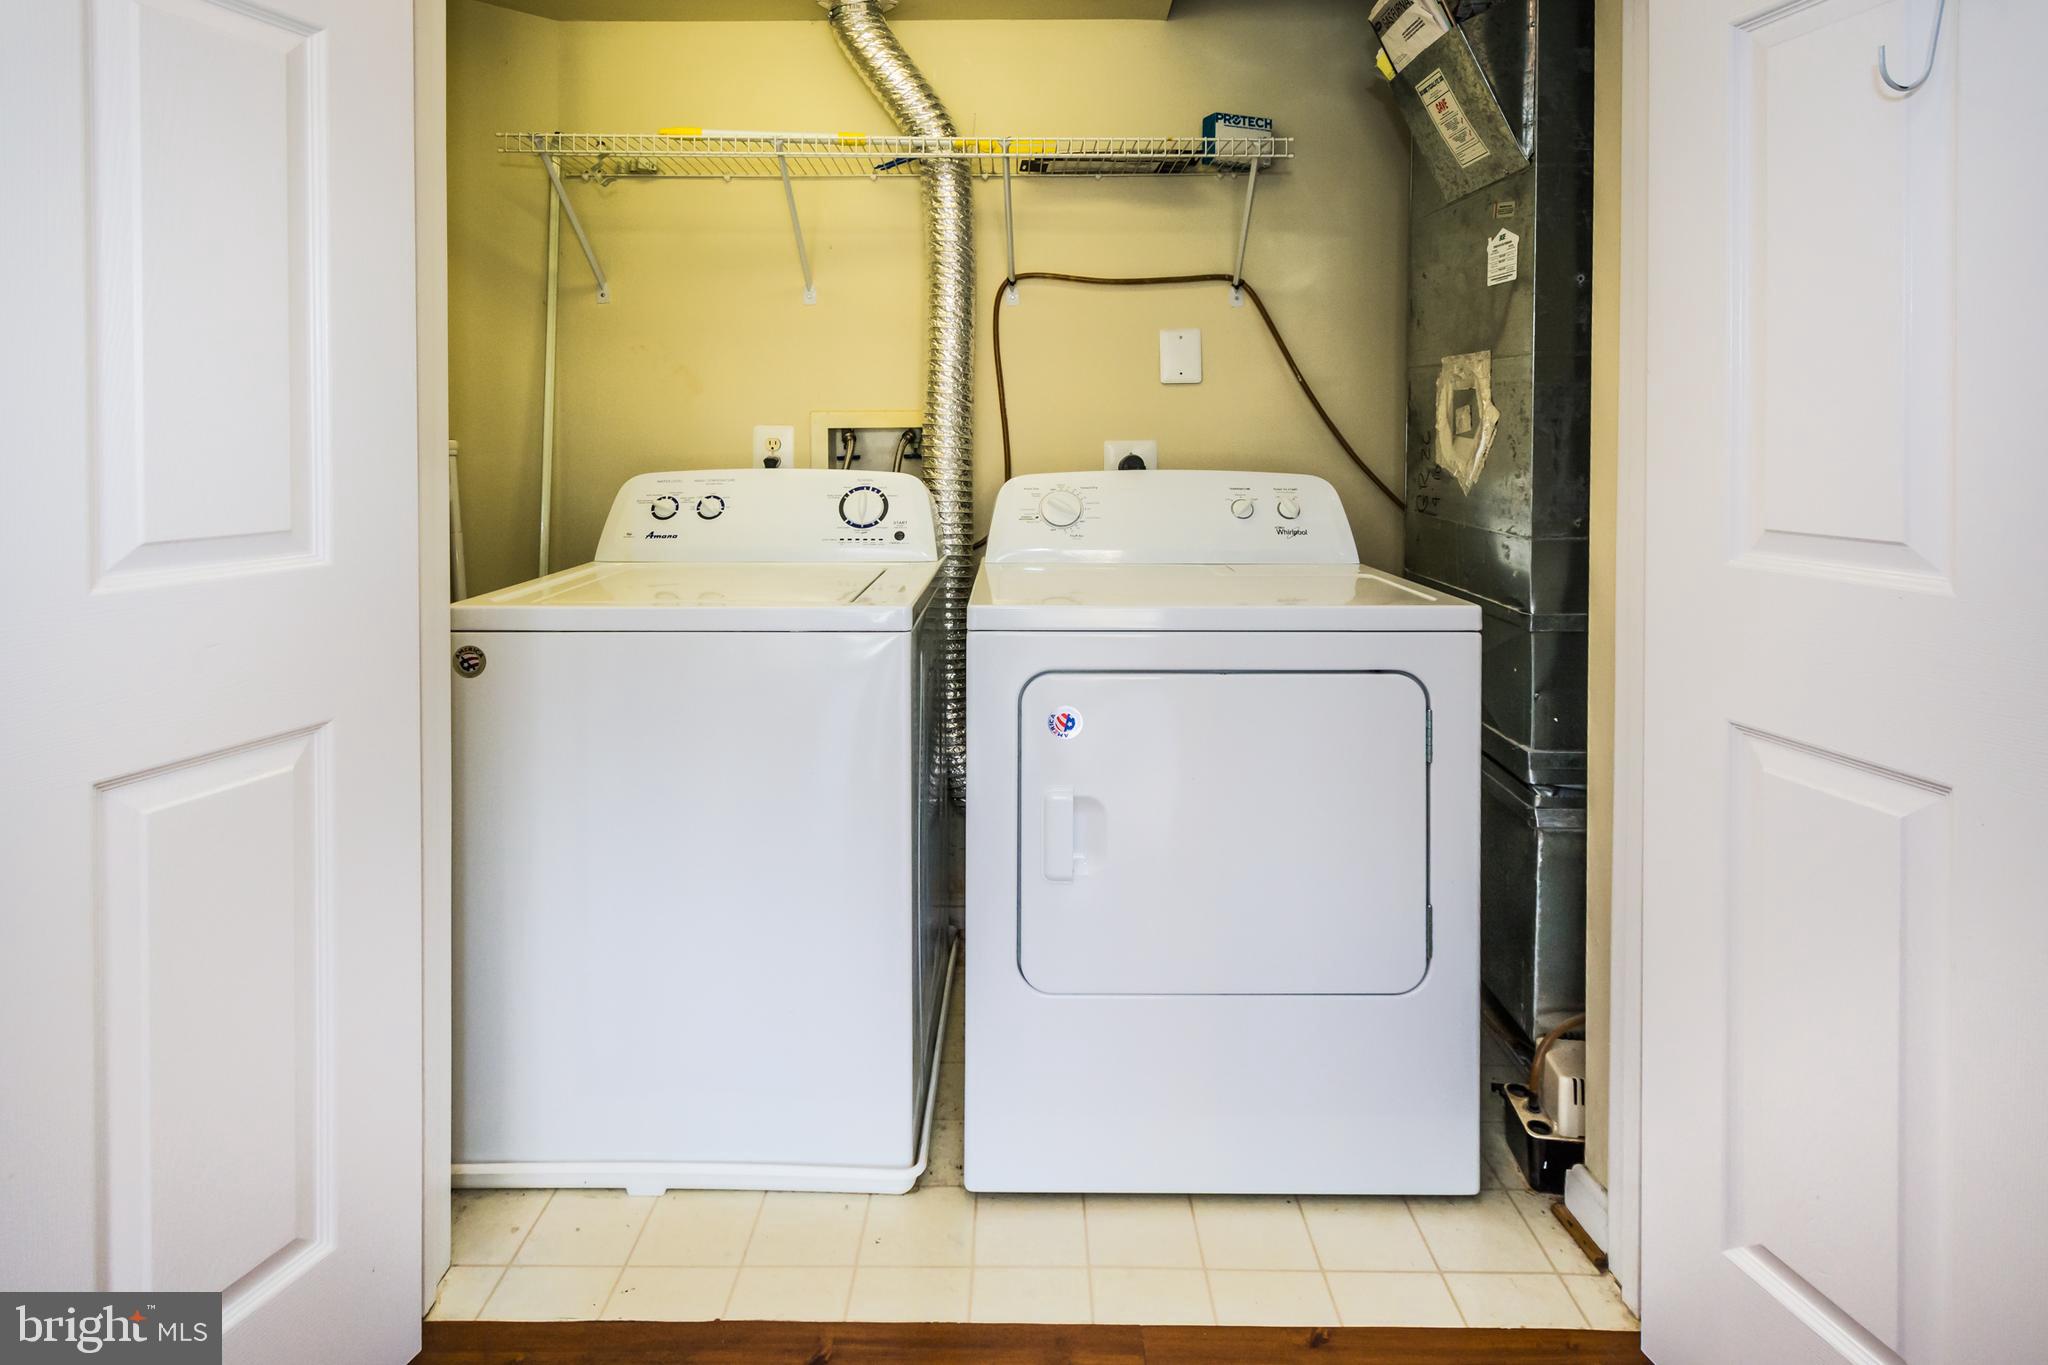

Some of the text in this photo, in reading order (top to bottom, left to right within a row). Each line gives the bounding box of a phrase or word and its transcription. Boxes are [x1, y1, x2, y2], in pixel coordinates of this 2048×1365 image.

[1215, 112, 1273, 130] PROTECH
[644, 530, 679, 540] Amana
[1275, 528, 1308, 537] Whirlpool
